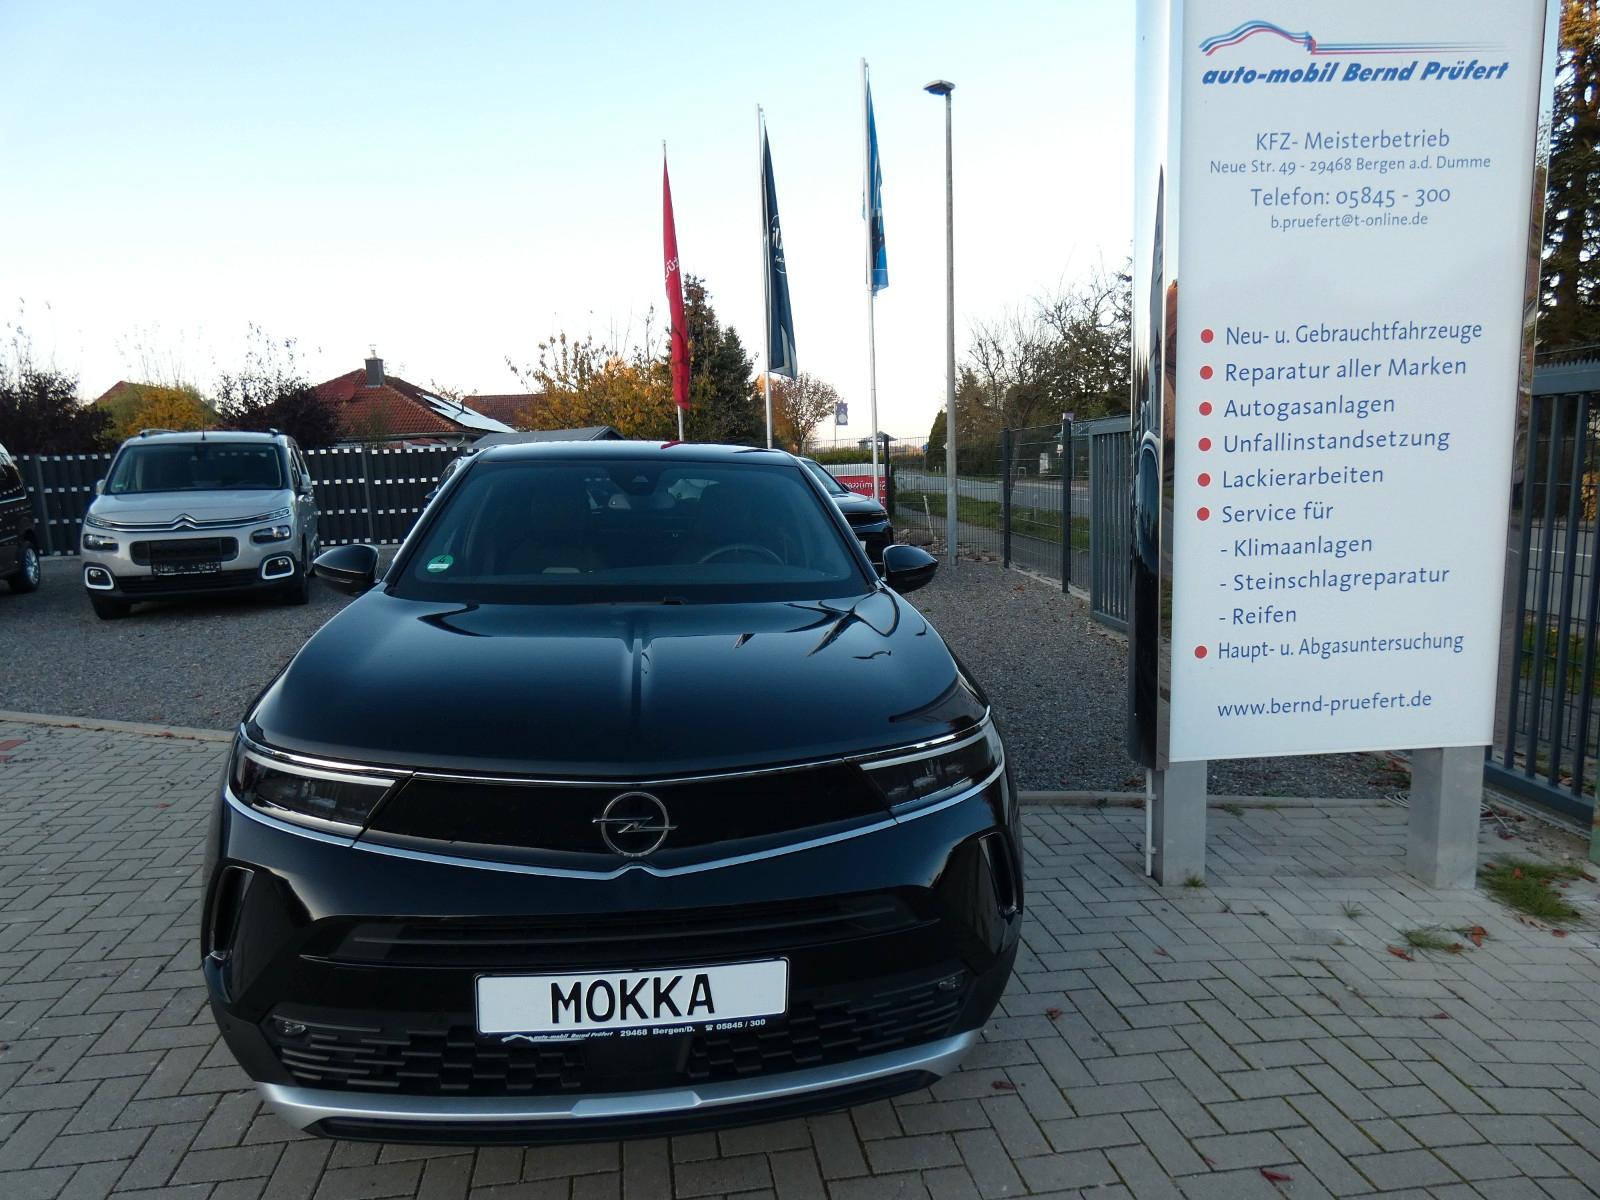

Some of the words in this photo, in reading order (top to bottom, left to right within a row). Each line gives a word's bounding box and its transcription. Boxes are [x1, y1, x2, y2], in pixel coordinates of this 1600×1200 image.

[1202, 62, 1339, 84] auto-mobil
[1341, 61, 1416, 82] Bernd
[1420, 60, 1509, 80] Prüfert
[1256, 132, 1299, 151] KFZ-
[1304, 129, 1450, 149] Meisterbetrieb
[1210, 160, 1247, 174] Neue
[1251, 159, 1275, 173] Str.
[1278, 161, 1297, 175] 49
[1309, 158, 1352, 173] 29468
[1356, 157, 1405, 173] Bergen
[1409, 156, 1433, 170] a.d.
[1436, 156, 1491, 169] Dumme
[1250, 187, 1331, 207] Telefon:
[1335, 186, 1396, 209] 05845
[1415, 188, 1451, 207] 300
[1271, 213, 1428, 231] b.pruefert@t-online.de
[1226, 327, 1270, 345] Neu-
[1275, 327, 1291, 344] u.
[1295, 321, 1483, 344] Gebrauchtfahrzeuge
[1225, 362, 1330, 386] Reparatur
[1336, 359, 1382, 379] aller
[1388, 356, 1467, 377] Marken
[1223, 395, 1395, 421] Autogasanlagen
[1224, 430, 1450, 452] Unfallinstandsetzung
[1223, 466, 1384, 488] Lackierarbeiten
[1222, 503, 1296, 523] Service
[1304, 501, 1333, 520] für
[1234, 536, 1373, 558] Klimaanlagen
[1234, 567, 1450, 591] Steinschlagreparatur
[1232, 605, 1297, 625] Reifen
[1218, 643, 1275, 663] Haupt-
[1280, 642, 1294, 656] u.
[1299, 632, 1464, 659] Abgasuntersuchung
[1217, 690, 1432, 718] www.bernd-pruefert.de
[551, 974, 715, 1023] MOKKA
[620, 1028, 648, 1037] 29468
[652, 1026, 696, 1036] Bergen/D.
[716, 1022, 742, 1031] 05845
[750, 1019, 766, 1028] 300
